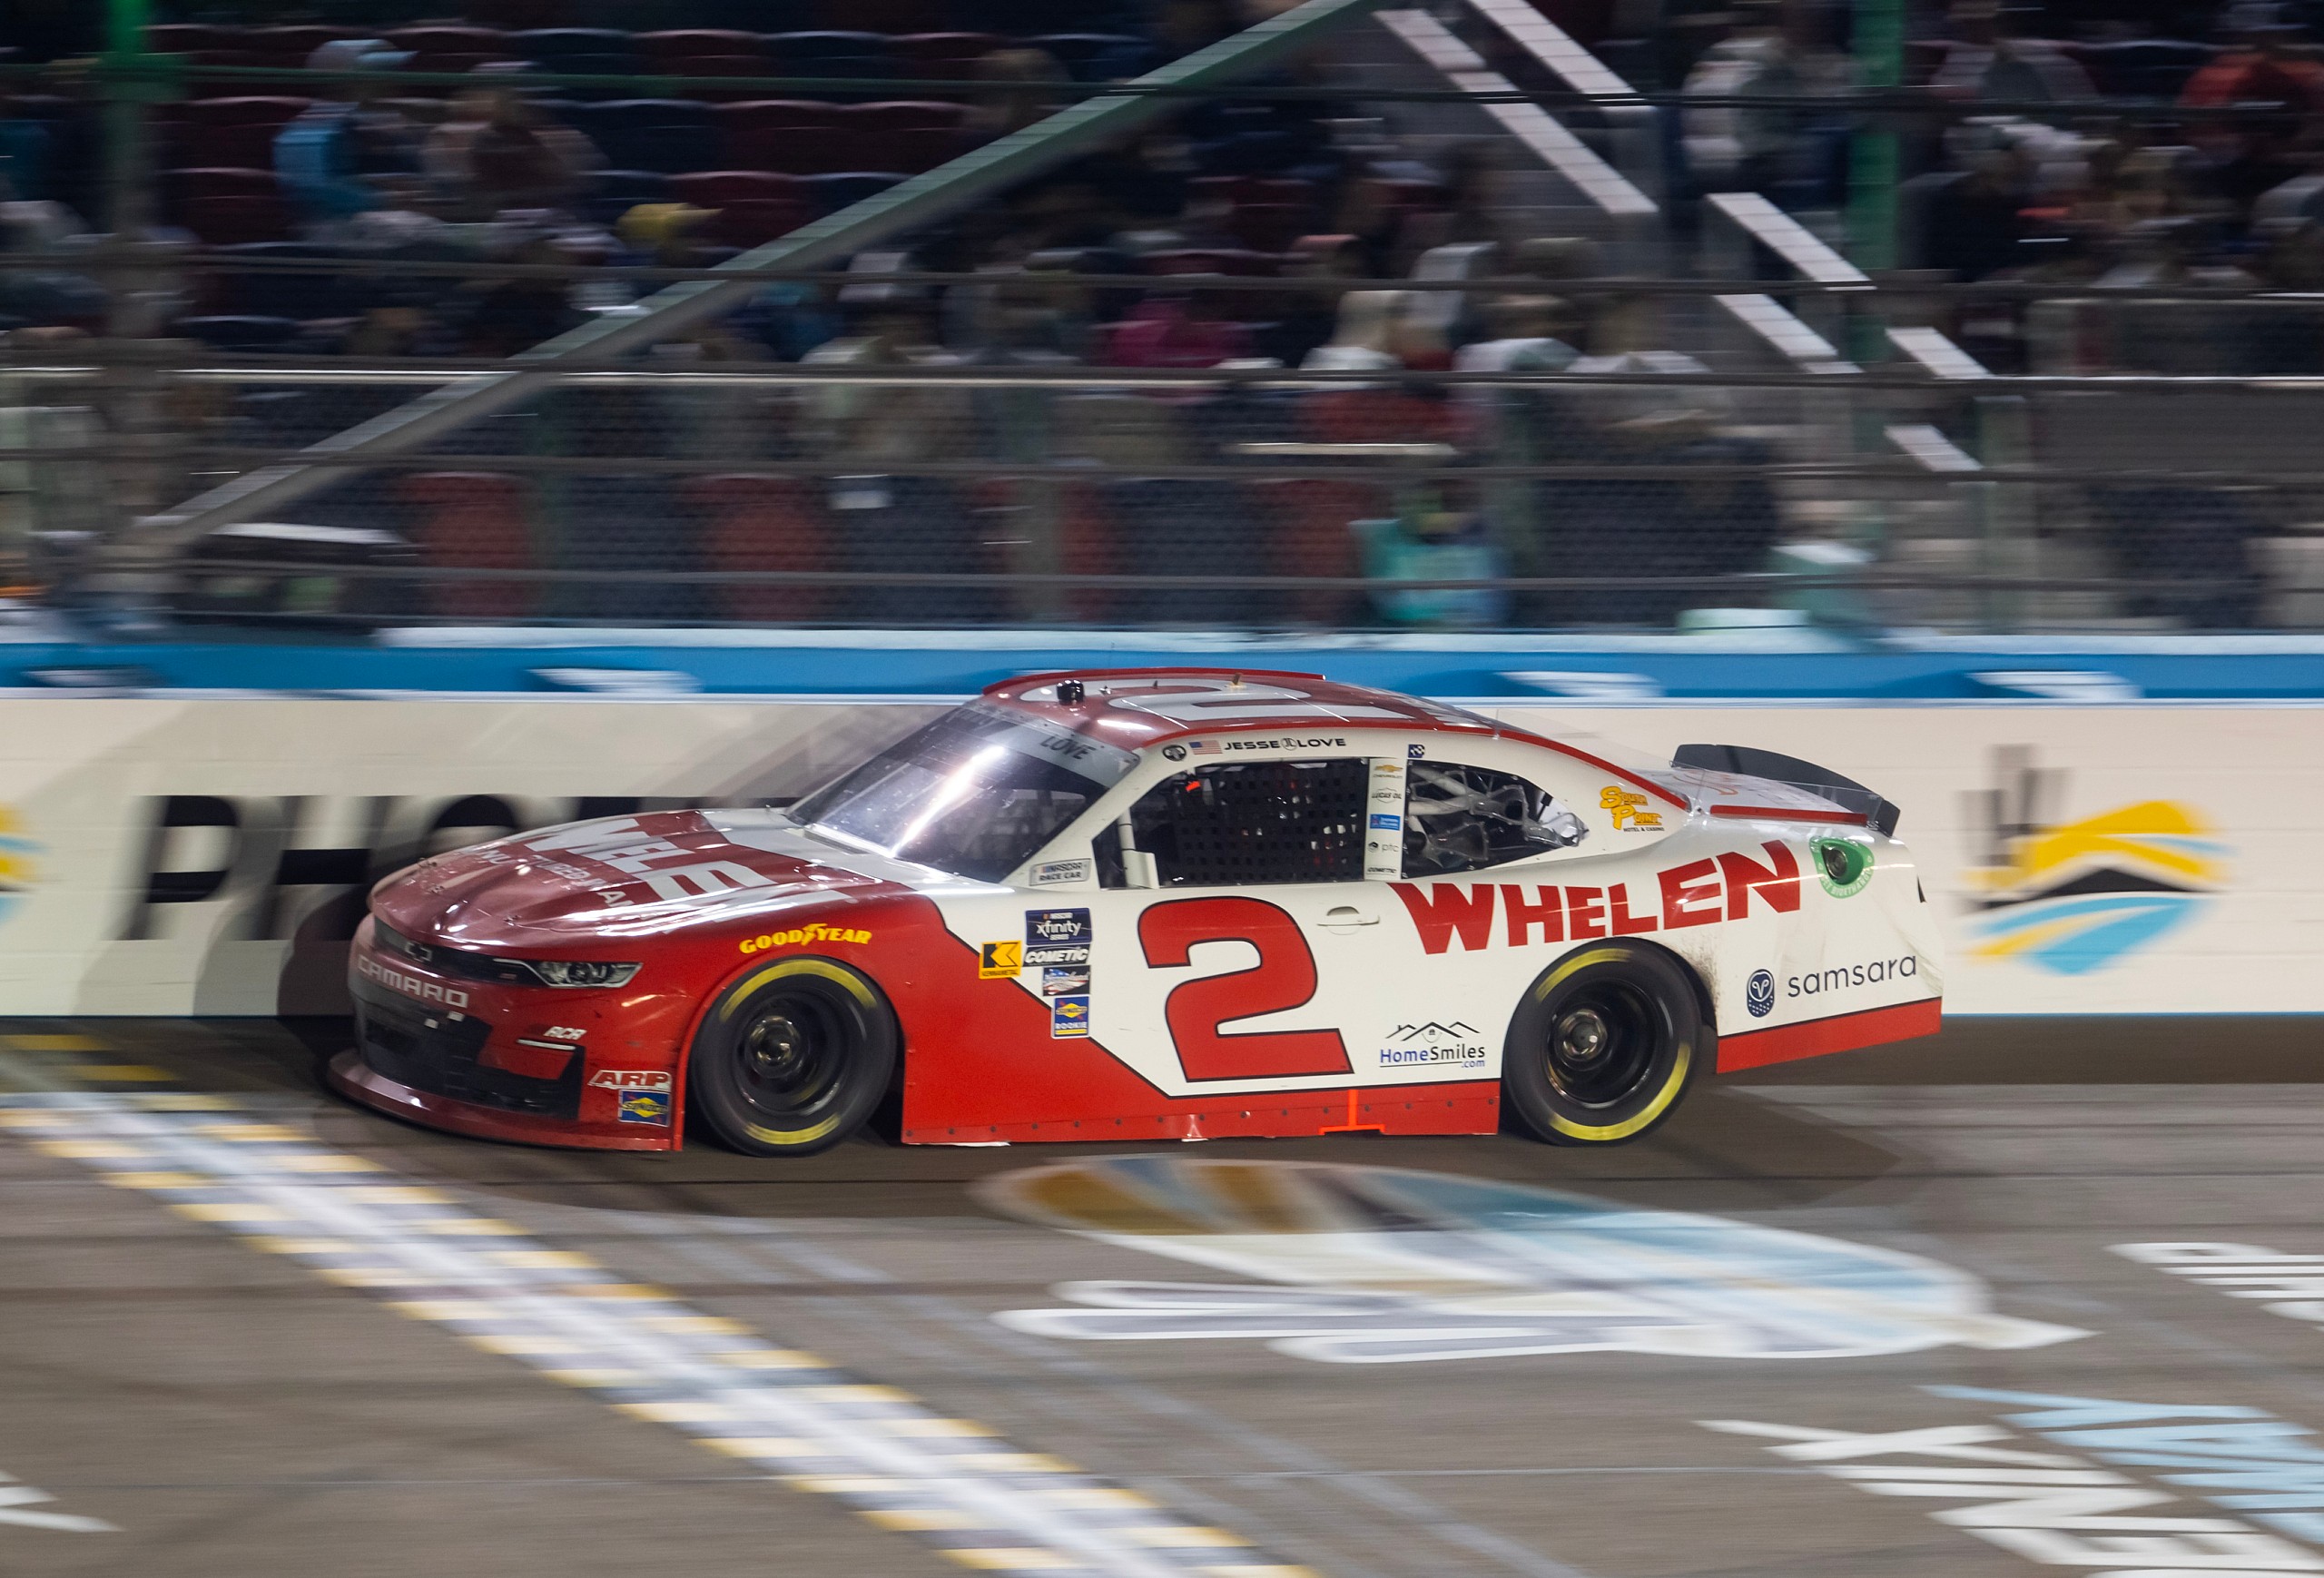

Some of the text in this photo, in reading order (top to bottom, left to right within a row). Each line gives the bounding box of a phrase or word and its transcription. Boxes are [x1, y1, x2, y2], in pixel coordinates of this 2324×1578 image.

[1040, 736, 1096, 759] LOVE
[1225, 740, 1279, 750] JESSE
[1298, 738, 1346, 748] LOVE
[1050, 863, 1082, 872] NASCAR
[1386, 839, 1801, 955] WHELEN
[739, 923, 872, 953] GOODYEAR
[1037, 920, 1081, 938] xfinity
[1024, 949, 1088, 962] COMETIC
[358, 954, 468, 1009] CAMARO
[1787, 955, 1916, 997] samsara
[1137, 896, 1354, 1082] 2
[1380, 1043, 1485, 1063] HomeSmiles
[1462, 1060, 1485, 1068] .com
[595, 1072, 669, 1088] ARP
